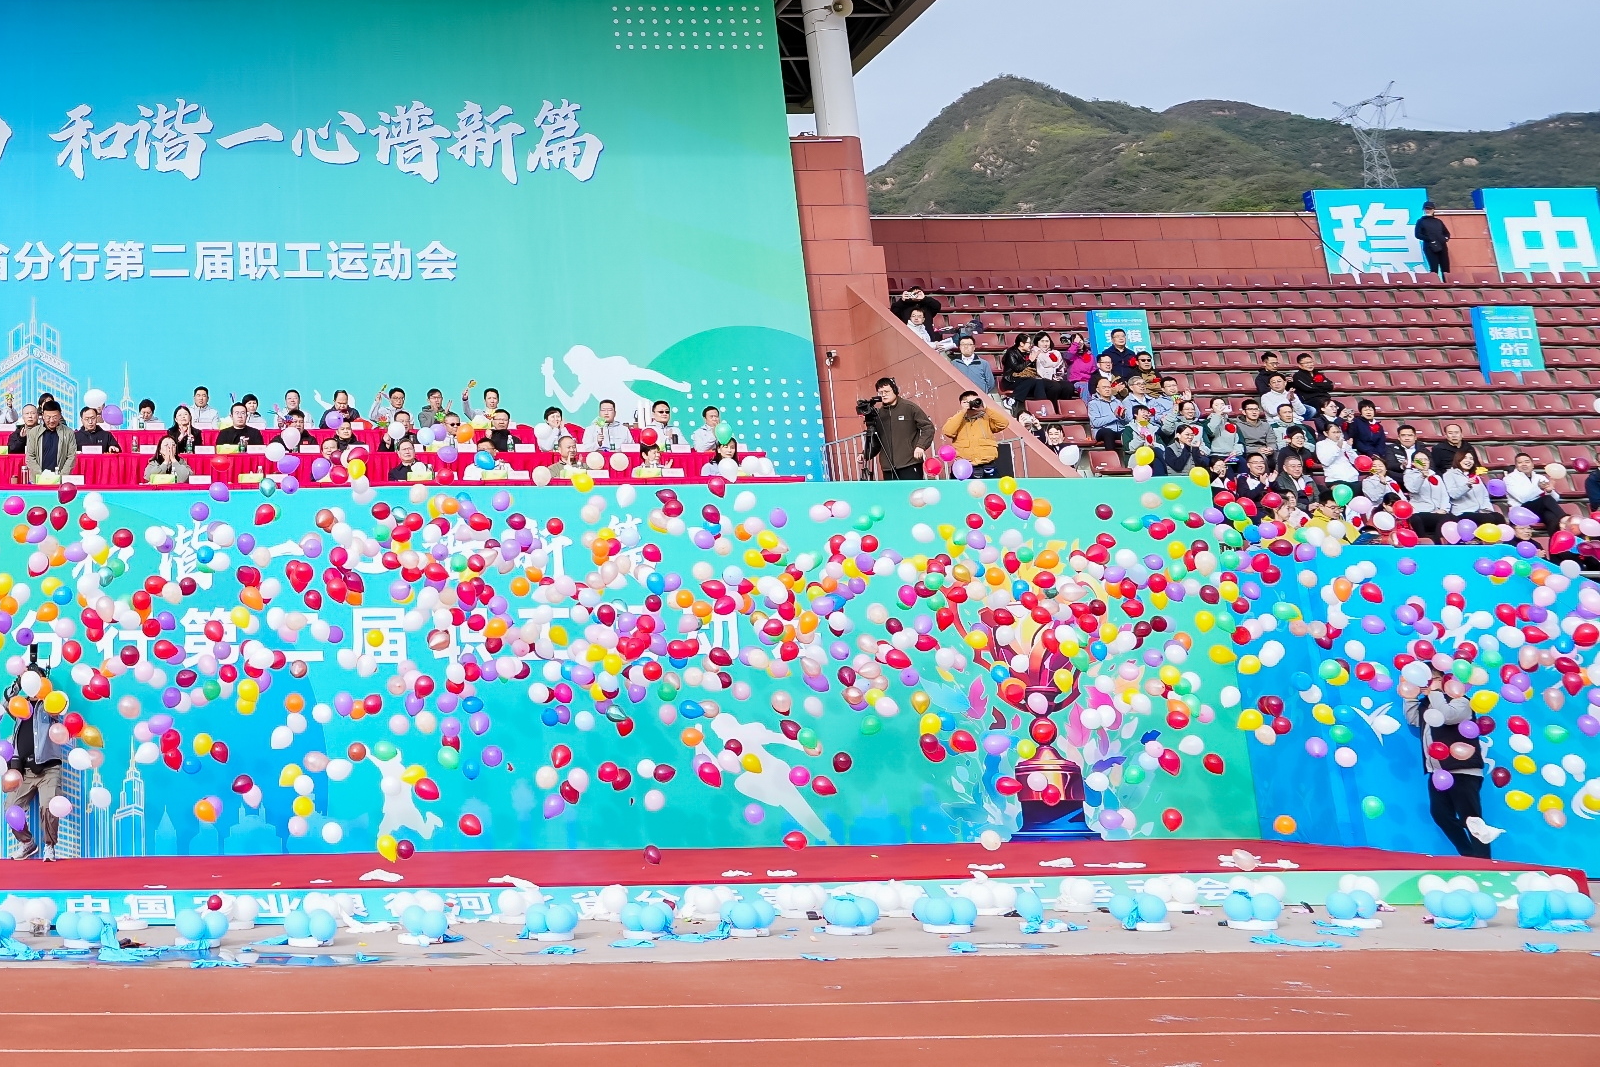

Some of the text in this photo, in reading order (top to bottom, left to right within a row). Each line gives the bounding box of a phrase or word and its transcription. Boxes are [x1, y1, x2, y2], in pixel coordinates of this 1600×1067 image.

[49, 98, 603, 184] 和谐一心谱新篇
[1328, 200, 1599, 283] 稳 中
[1488, 326, 1534, 340] 张家口
[1499, 342, 1529, 356] 分行
